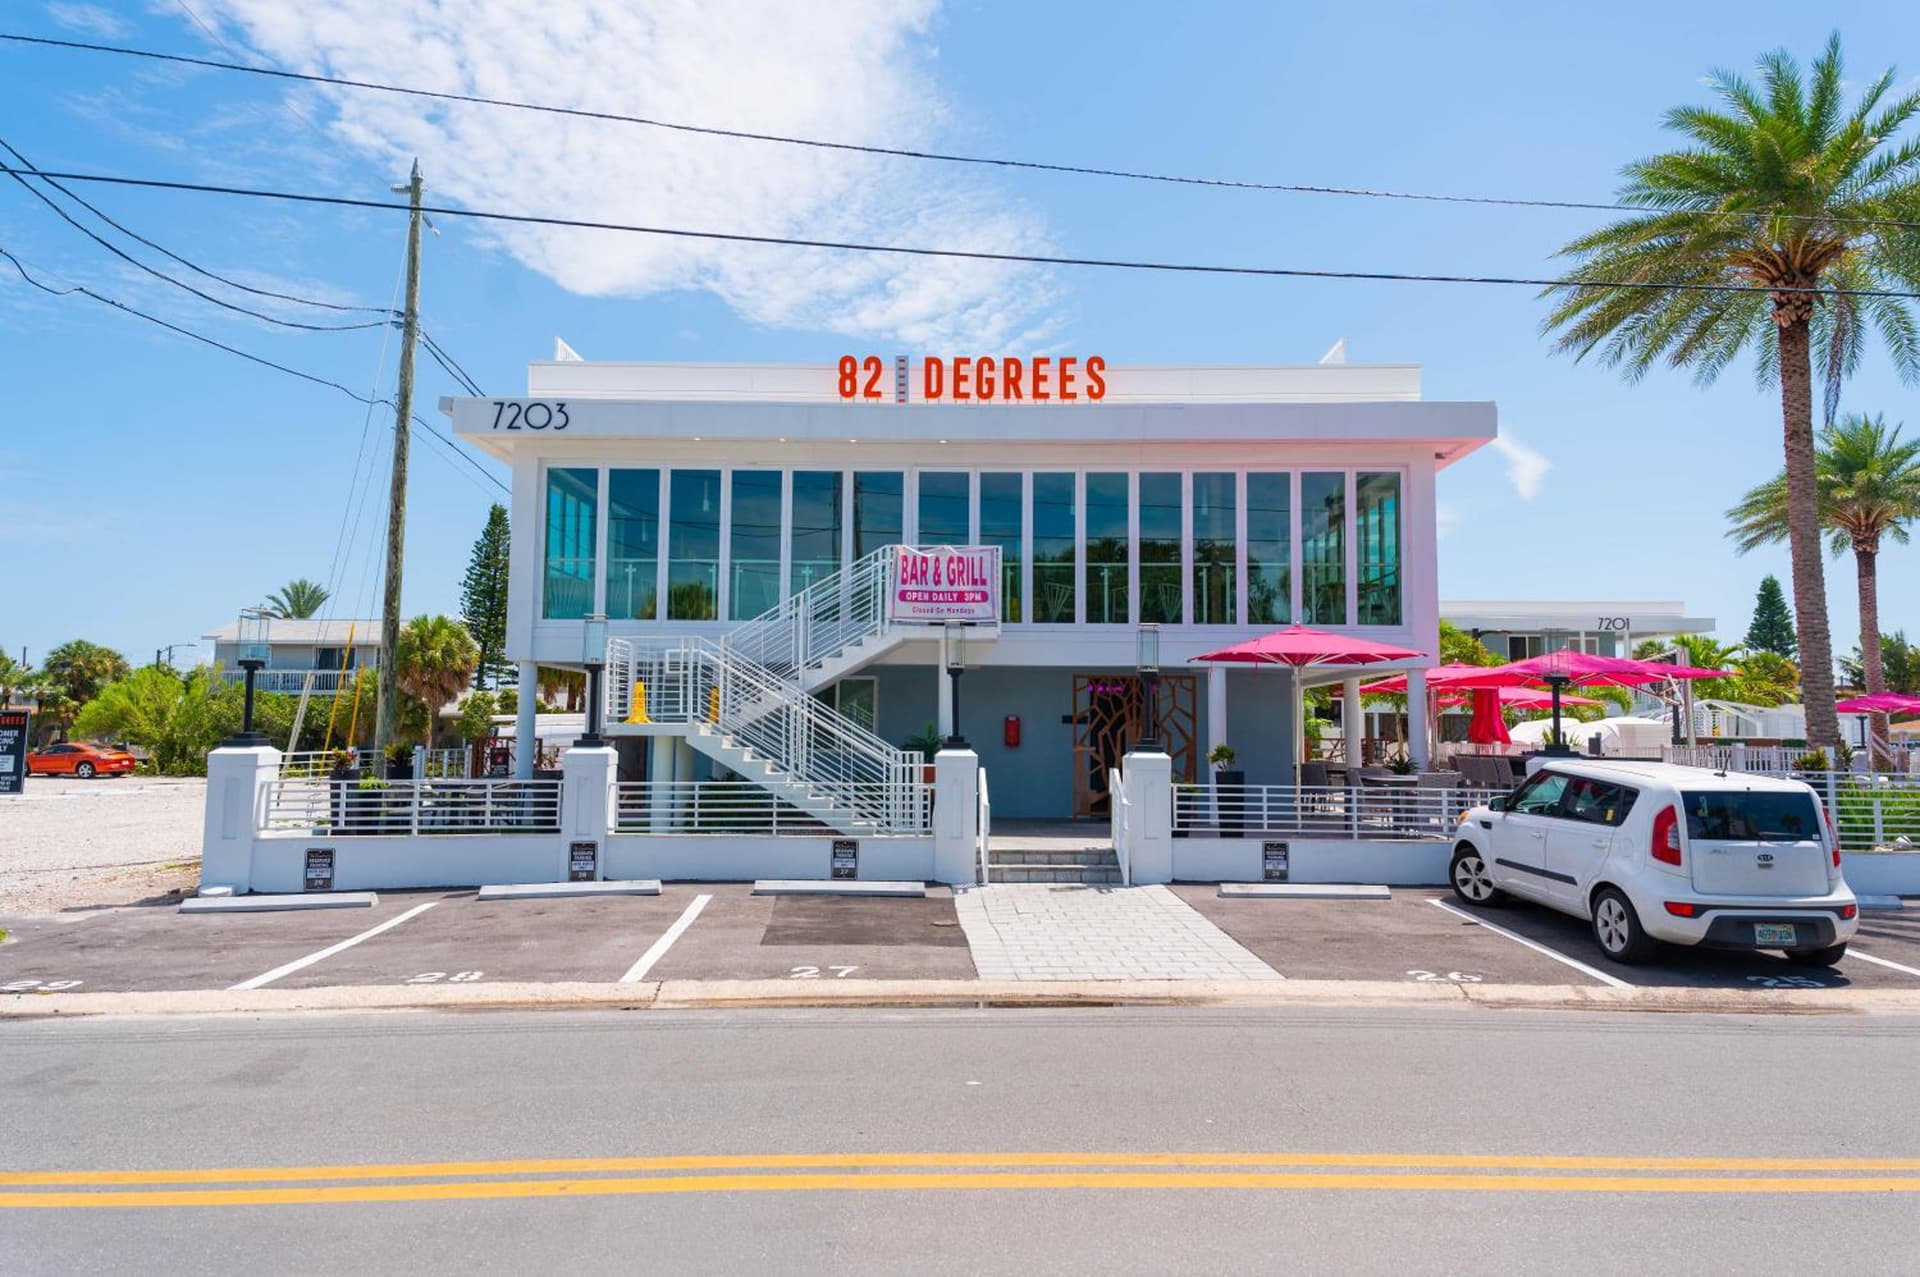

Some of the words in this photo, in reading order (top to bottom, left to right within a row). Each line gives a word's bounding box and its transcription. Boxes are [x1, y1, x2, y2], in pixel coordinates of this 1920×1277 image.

[838, 355, 882, 398] 82
[924, 356, 1106, 400] DEGREES
[493, 402, 569, 430] 7203
[901, 555, 929, 585] BAR
[933, 556, 942, 586] &
[947, 556, 987, 586] GRILL
[906, 592, 929, 601] OPEN
[932, 592, 958, 602] DAILY
[964, 592, 982, 602] 3PM
[912, 606, 933, 614] Closed
[1598, 617, 1630, 630] 7201
[404, 971, 484, 983] 28
[790, 966, 859, 978] 27
[1406, 970, 1482, 982] 26
[0, 980, 84, 990] 29
